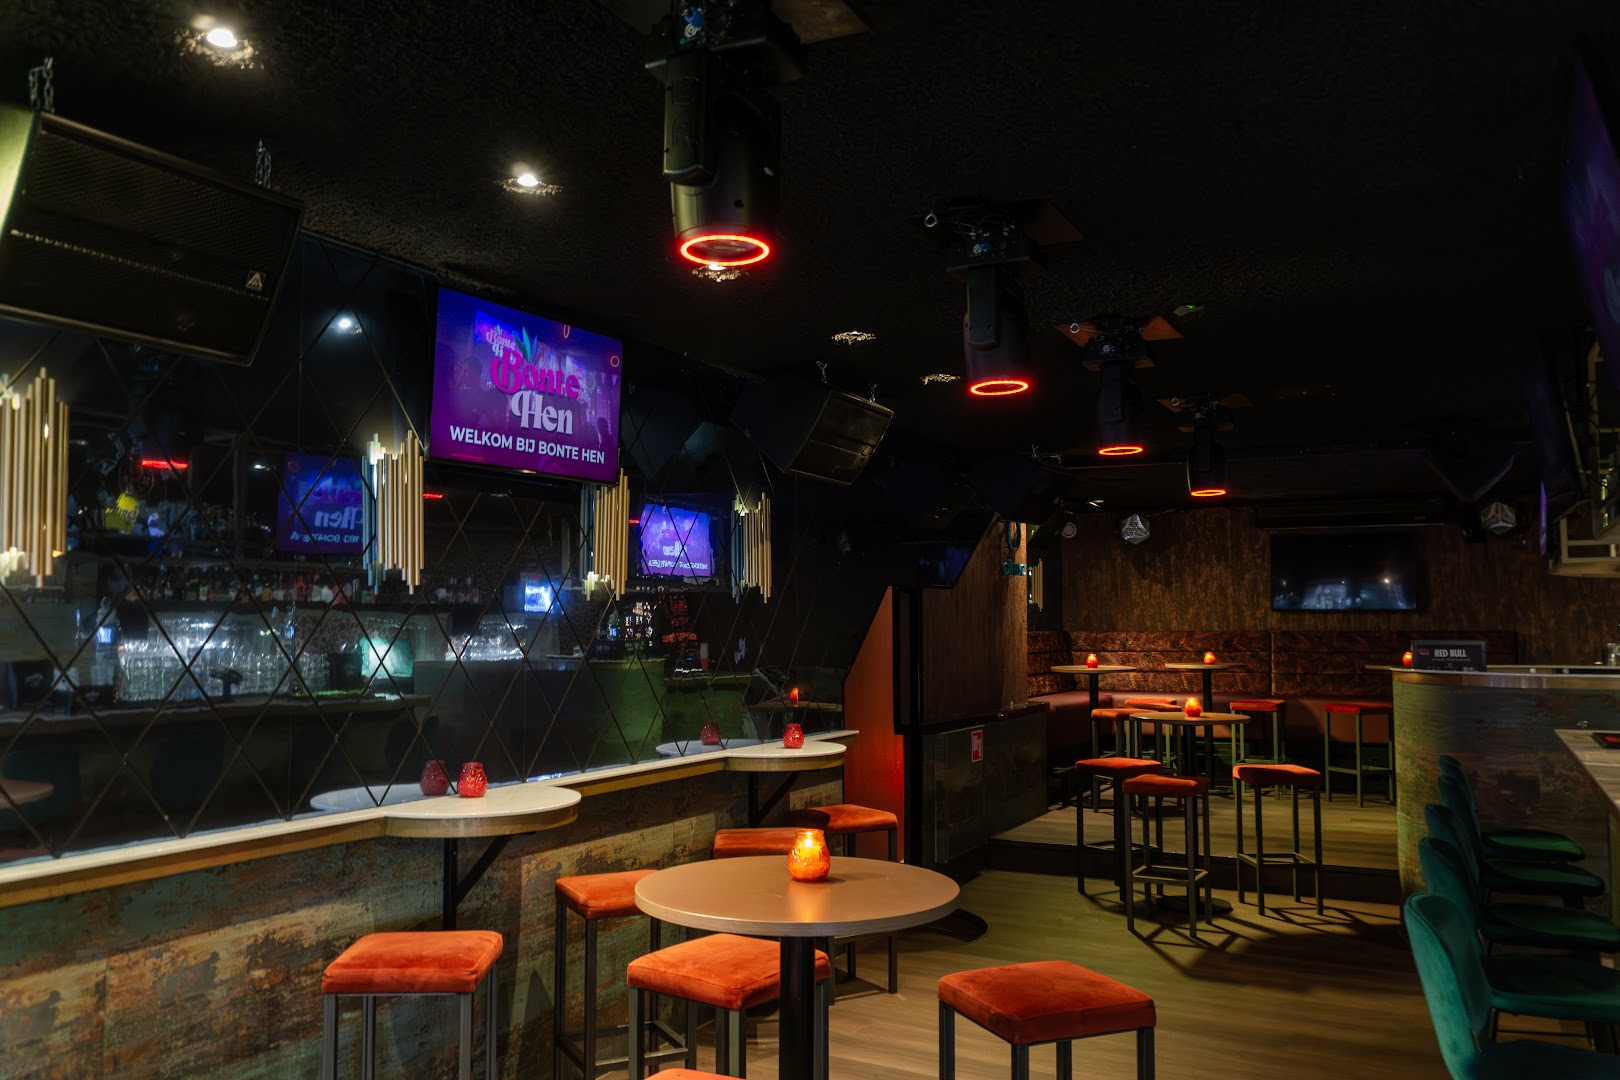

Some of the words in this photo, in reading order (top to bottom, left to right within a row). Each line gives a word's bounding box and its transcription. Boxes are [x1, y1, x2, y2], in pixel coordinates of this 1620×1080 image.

[490, 349, 581, 399] Bonte
[511, 390, 573, 435] Hen
[450, 425, 513, 450] WELKOM
[516, 437, 535, 453] BIJ
[539, 441, 579, 460] BONTE
[582, 448, 605, 464] HEN
[1434, 649, 1449, 658] RED
[1449, 649, 1467, 658] BULL
